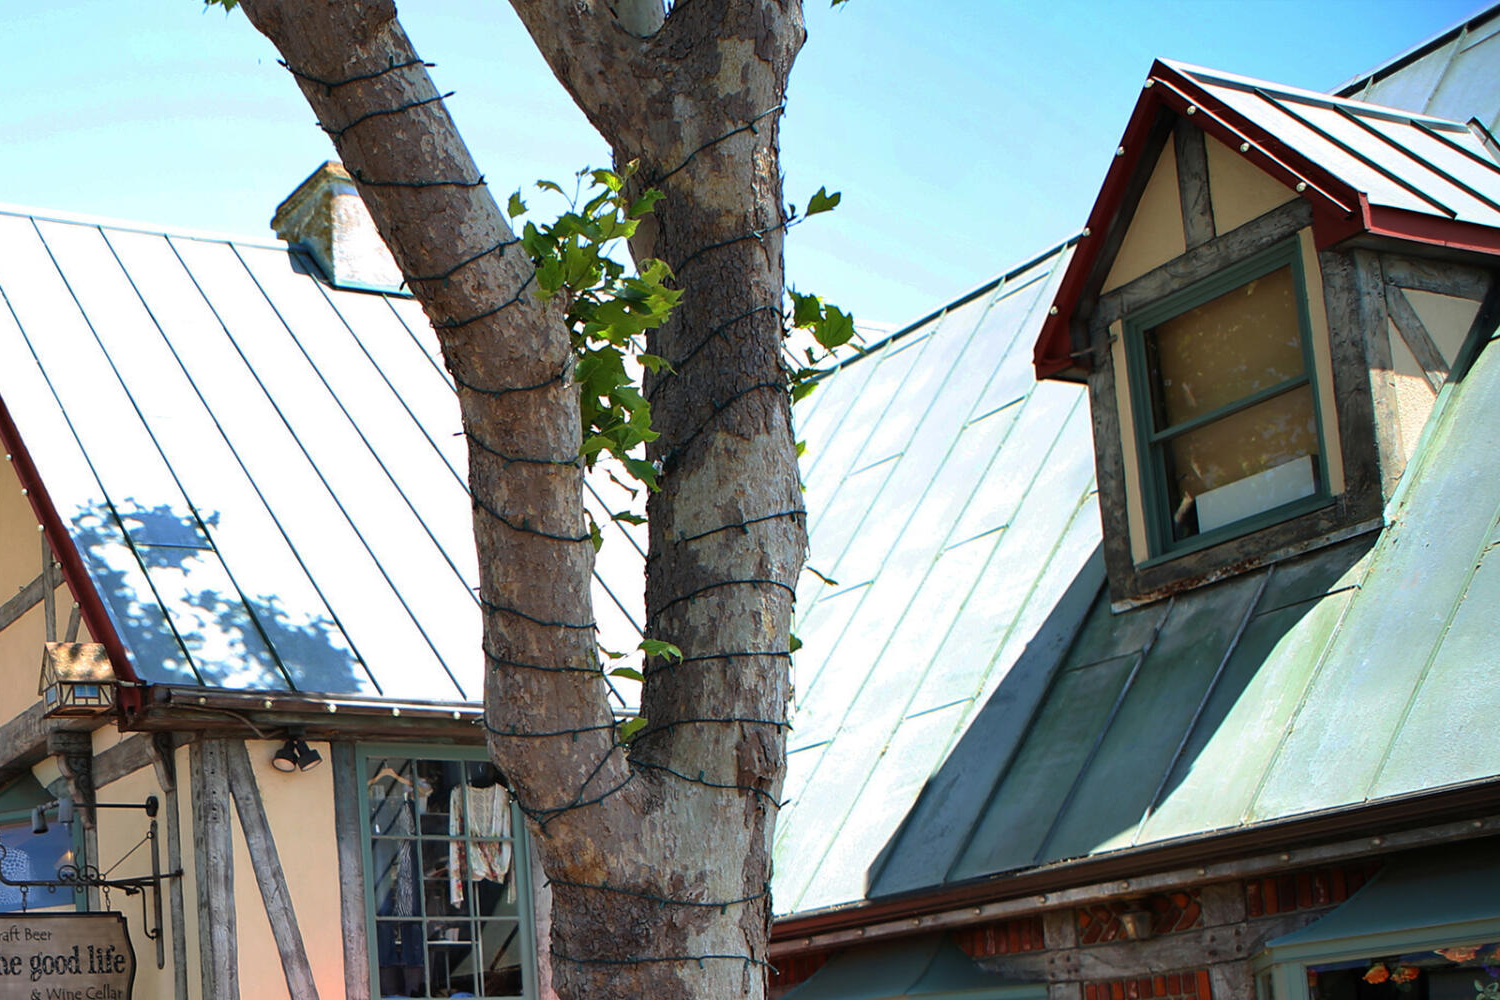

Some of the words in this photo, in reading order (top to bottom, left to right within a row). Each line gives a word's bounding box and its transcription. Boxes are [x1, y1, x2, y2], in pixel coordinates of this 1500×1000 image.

[24, 927, 52, 941] Beer
[29, 944, 82, 982] good
[87, 944, 126, 974] life
[46, 987, 83, 1000] Wine
[85, 983, 124, 1000] Cellar
